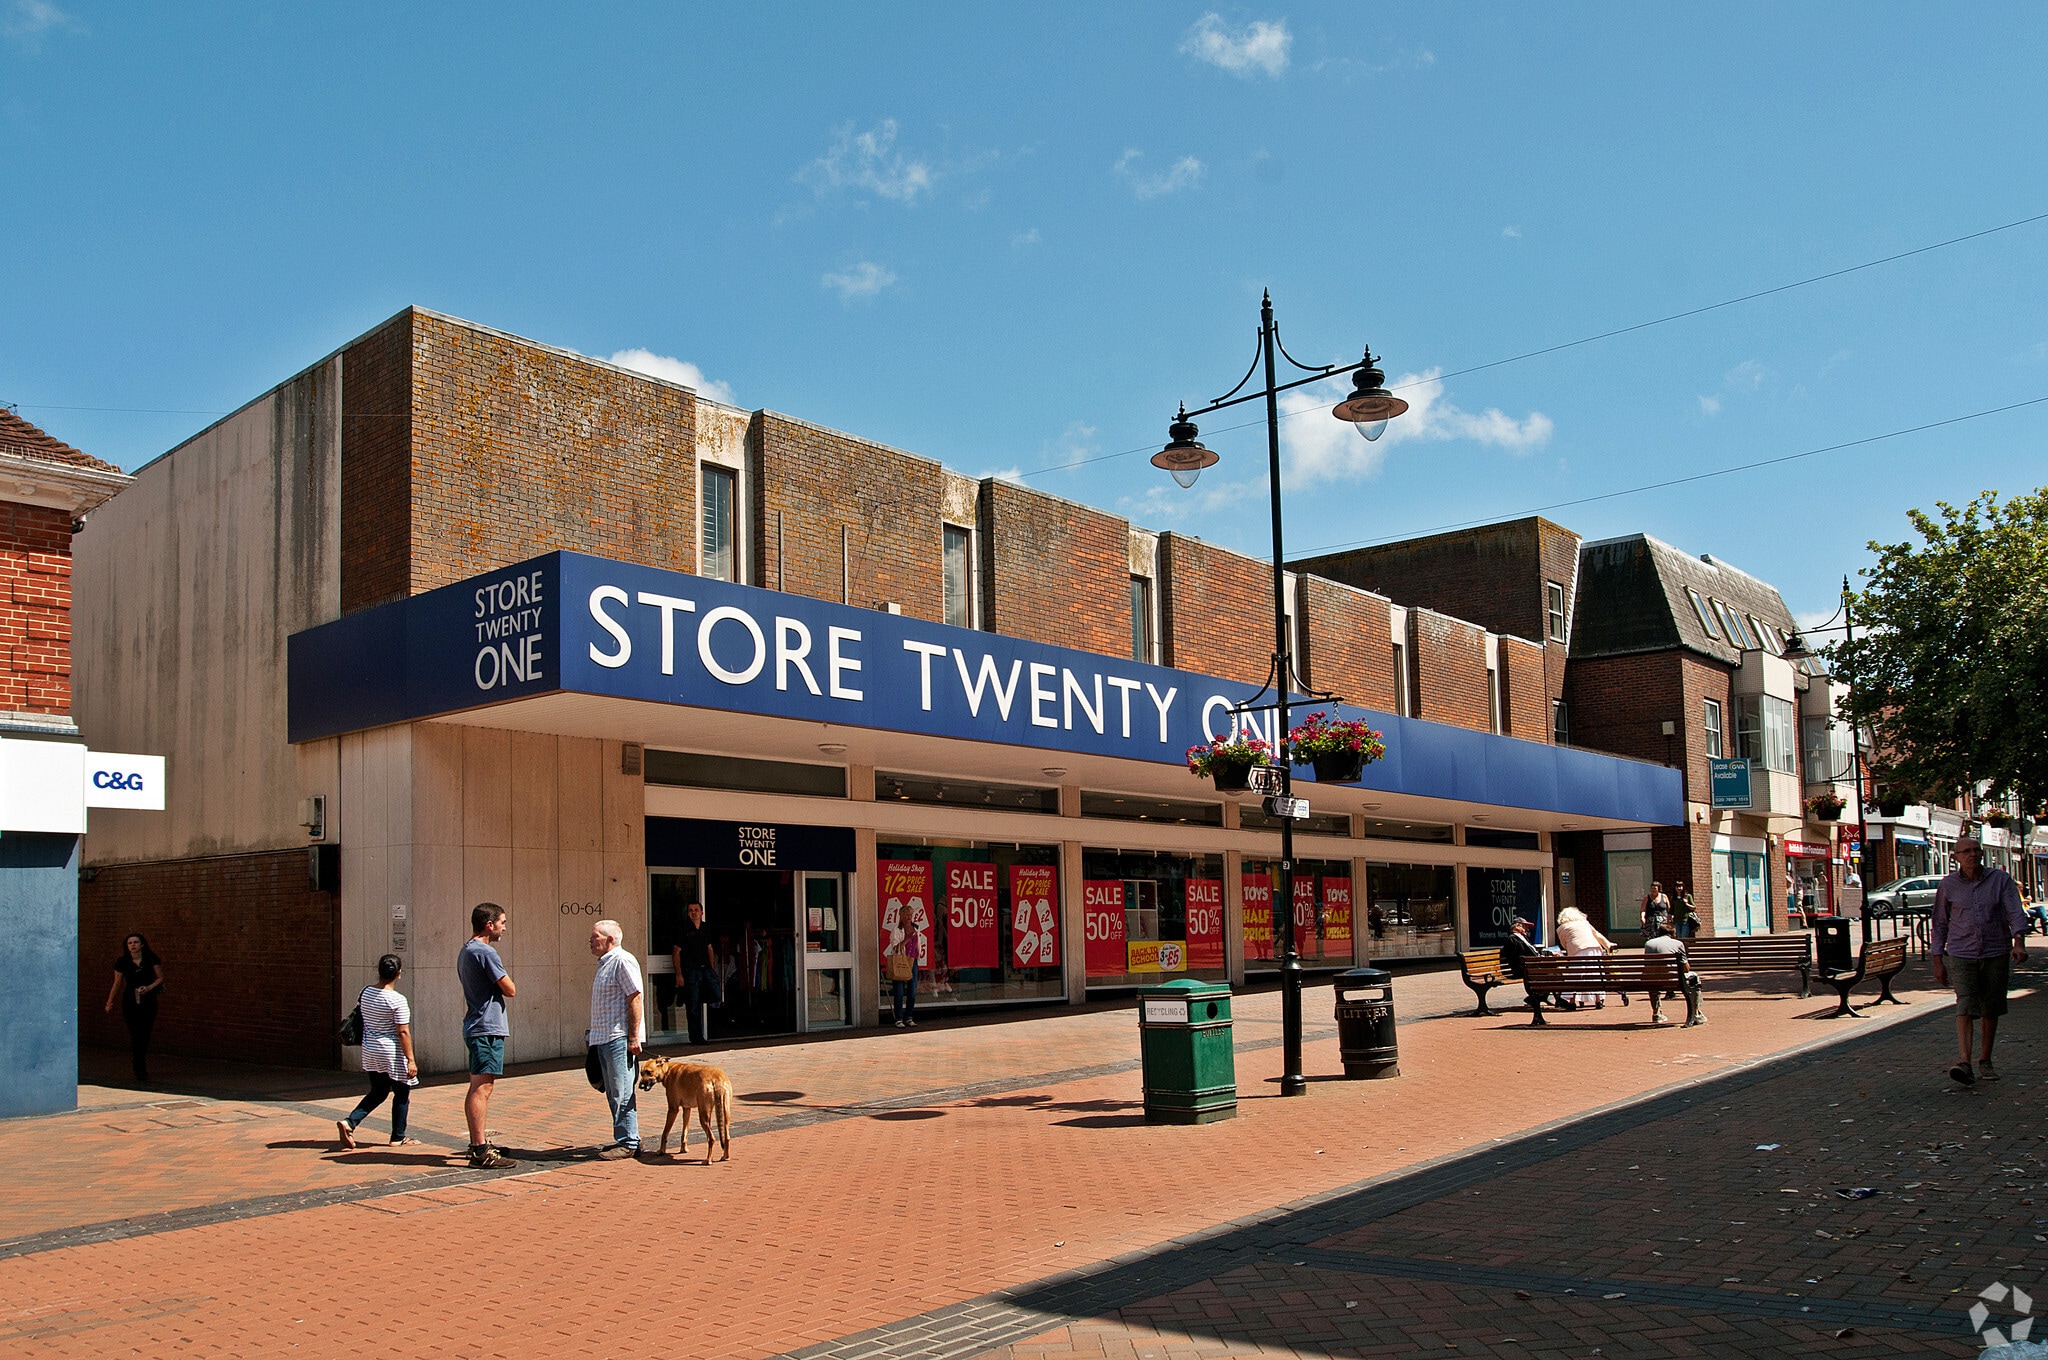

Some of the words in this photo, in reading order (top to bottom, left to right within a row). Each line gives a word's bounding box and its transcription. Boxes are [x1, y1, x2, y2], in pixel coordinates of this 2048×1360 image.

[475, 570, 543, 618] STORE
[475, 606, 542, 643] TWENTY
[475, 633, 543, 690] ONE
[589, 585, 863, 701] STORE
[903, 639, 1177, 743] TWENTY
[1202, 695, 1293, 761] ONE
[93, 771, 143, 791] C&G
[738, 827, 776, 840] STORE
[739, 839, 776, 848] TWENTY
[739, 848, 777, 866] ONE
[888, 863, 910, 874] Holiday
[911, 864, 925, 874] Shop
[1019, 868, 1038, 878] Holiday
[1038, 869, 1051, 878] Shop
[884, 873, 907, 895] 1/2
[906, 876, 926, 885] PRICE
[951, 869, 994, 890] SALE
[1016, 877, 1035, 897] 1/2
[1035, 880, 1051, 888] PRICE
[1490, 880, 1516, 893] STORE
[906, 884, 923, 893] SALE
[1034, 887, 1049, 896] SALE
[1086, 887, 1122, 905] SALE
[1188, 885, 1219, 902] SALE
[1244, 886, 1269, 901] TOYS
[1293, 881, 1313, 896] ALE
[1327, 889, 1349, 902] TOYS
[1492, 895, 1516, 905] TWENTY
[561, 902, 602, 915] 60-64
[886, 908, 898, 924] £1
[913, 908, 925, 922] £2
[951, 897, 994, 928] 50%
[979, 919, 994, 928] OFF
[1293, 902, 1314, 926] 0%
[1492, 906, 1517, 926] ONE
[1018, 910, 1028, 924] £1
[1040, 910, 1051, 923] £2
[1189, 909, 1220, 935] 50%
[1209, 927, 1220, 935] OFF
[1243, 909, 1270, 924] HALF
[1326, 909, 1349, 924] HALF
[1086, 912, 1122, 941] 50%
[1110, 931, 1122, 940] OFF
[1243, 927, 1270, 941] PRICE
[1326, 927, 1350, 940] PRICE
[920, 944, 926, 959] 5
[1021, 941, 1033, 955] £2
[1041, 942, 1052, 956] £5
[1131, 948, 1148, 957] BACK
[1131, 953, 1158, 965] SCHOOL
[1160, 951, 1165, 962] 3
[1167, 949, 1179, 967] £5
[1147, 1007, 1178, 1016] RECYCLING
[1343, 1007, 1388, 1018] LITTER
